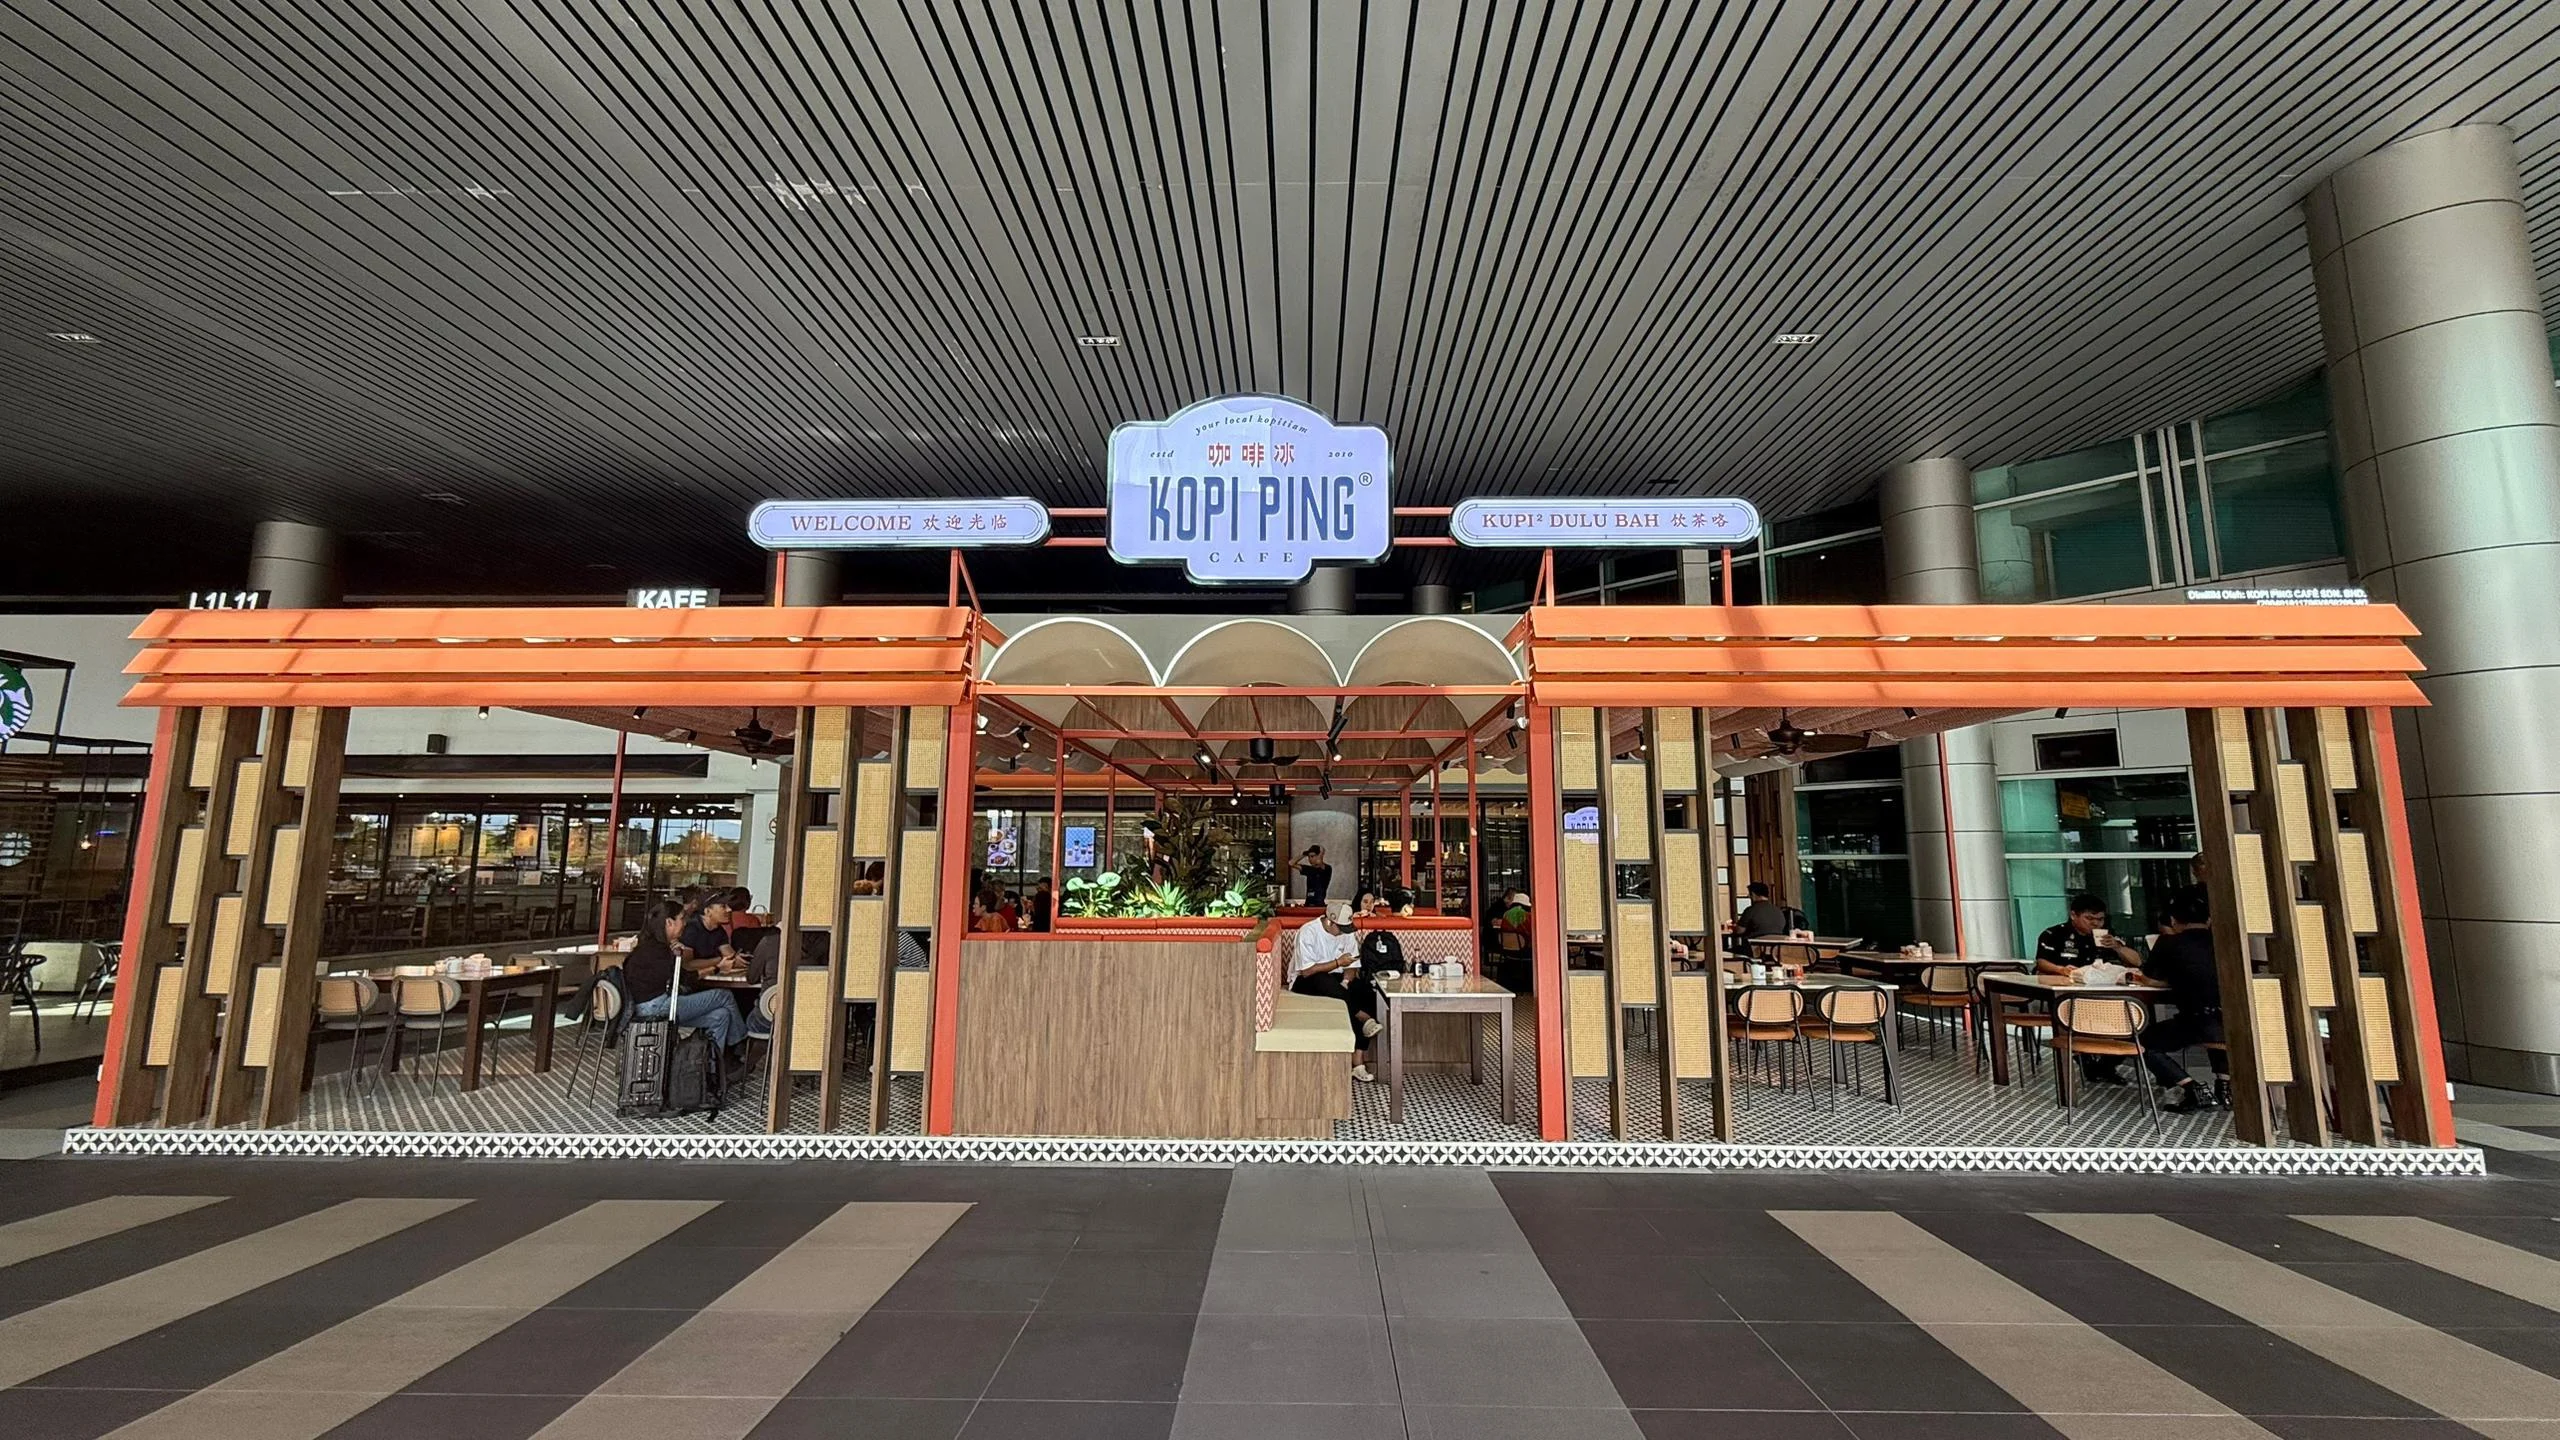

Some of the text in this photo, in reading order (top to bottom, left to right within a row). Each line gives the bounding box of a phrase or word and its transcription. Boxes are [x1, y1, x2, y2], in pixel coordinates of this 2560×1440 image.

[1196, 415, 1308, 436] your local kopitiam
[1150, 450, 1175, 458] estd
[1328, 450, 1353, 458] 2010
[1149, 476, 1239, 541] KOPI
[791, 513, 1008, 532] WELCOME 欢迎光临
[1551, 514, 1608, 528] DULU
[1615, 513, 1660, 527] BAH
[1671, 513, 1729, 528] 饮茶咯
[1209, 552, 1293, 564] CAFE
[189, 592, 259, 610] L1L11
[637, 589, 708, 609] KAFE
[2247, 589, 2269, 599] KOPI
